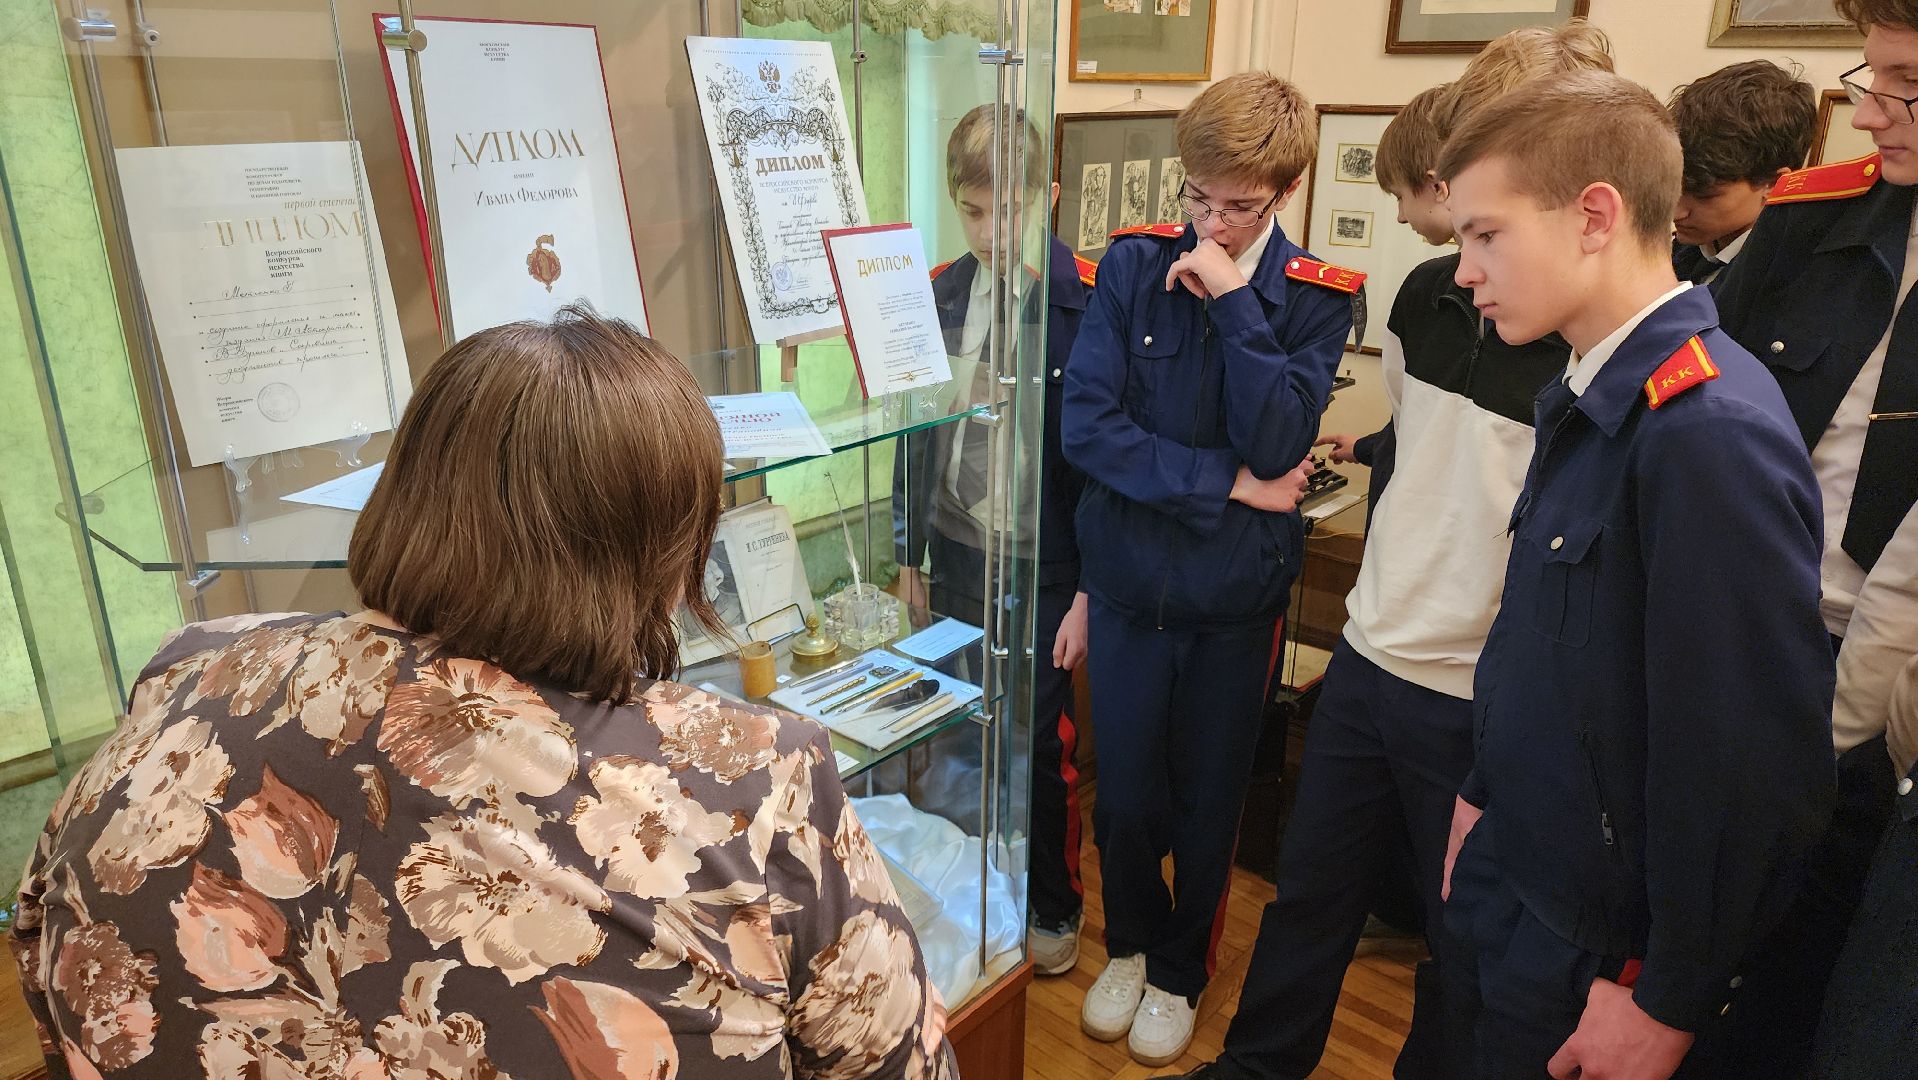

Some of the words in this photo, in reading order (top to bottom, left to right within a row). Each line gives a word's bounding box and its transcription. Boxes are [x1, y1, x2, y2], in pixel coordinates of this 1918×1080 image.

[451, 128, 585, 172] ДИПЛОМ
[755, 154, 826, 177] ДИПЛОМ
[264, 247, 323, 258] Всероссийского
[270, 271, 294, 279] книги
[857, 254, 914, 278] ДИПЛОМ
